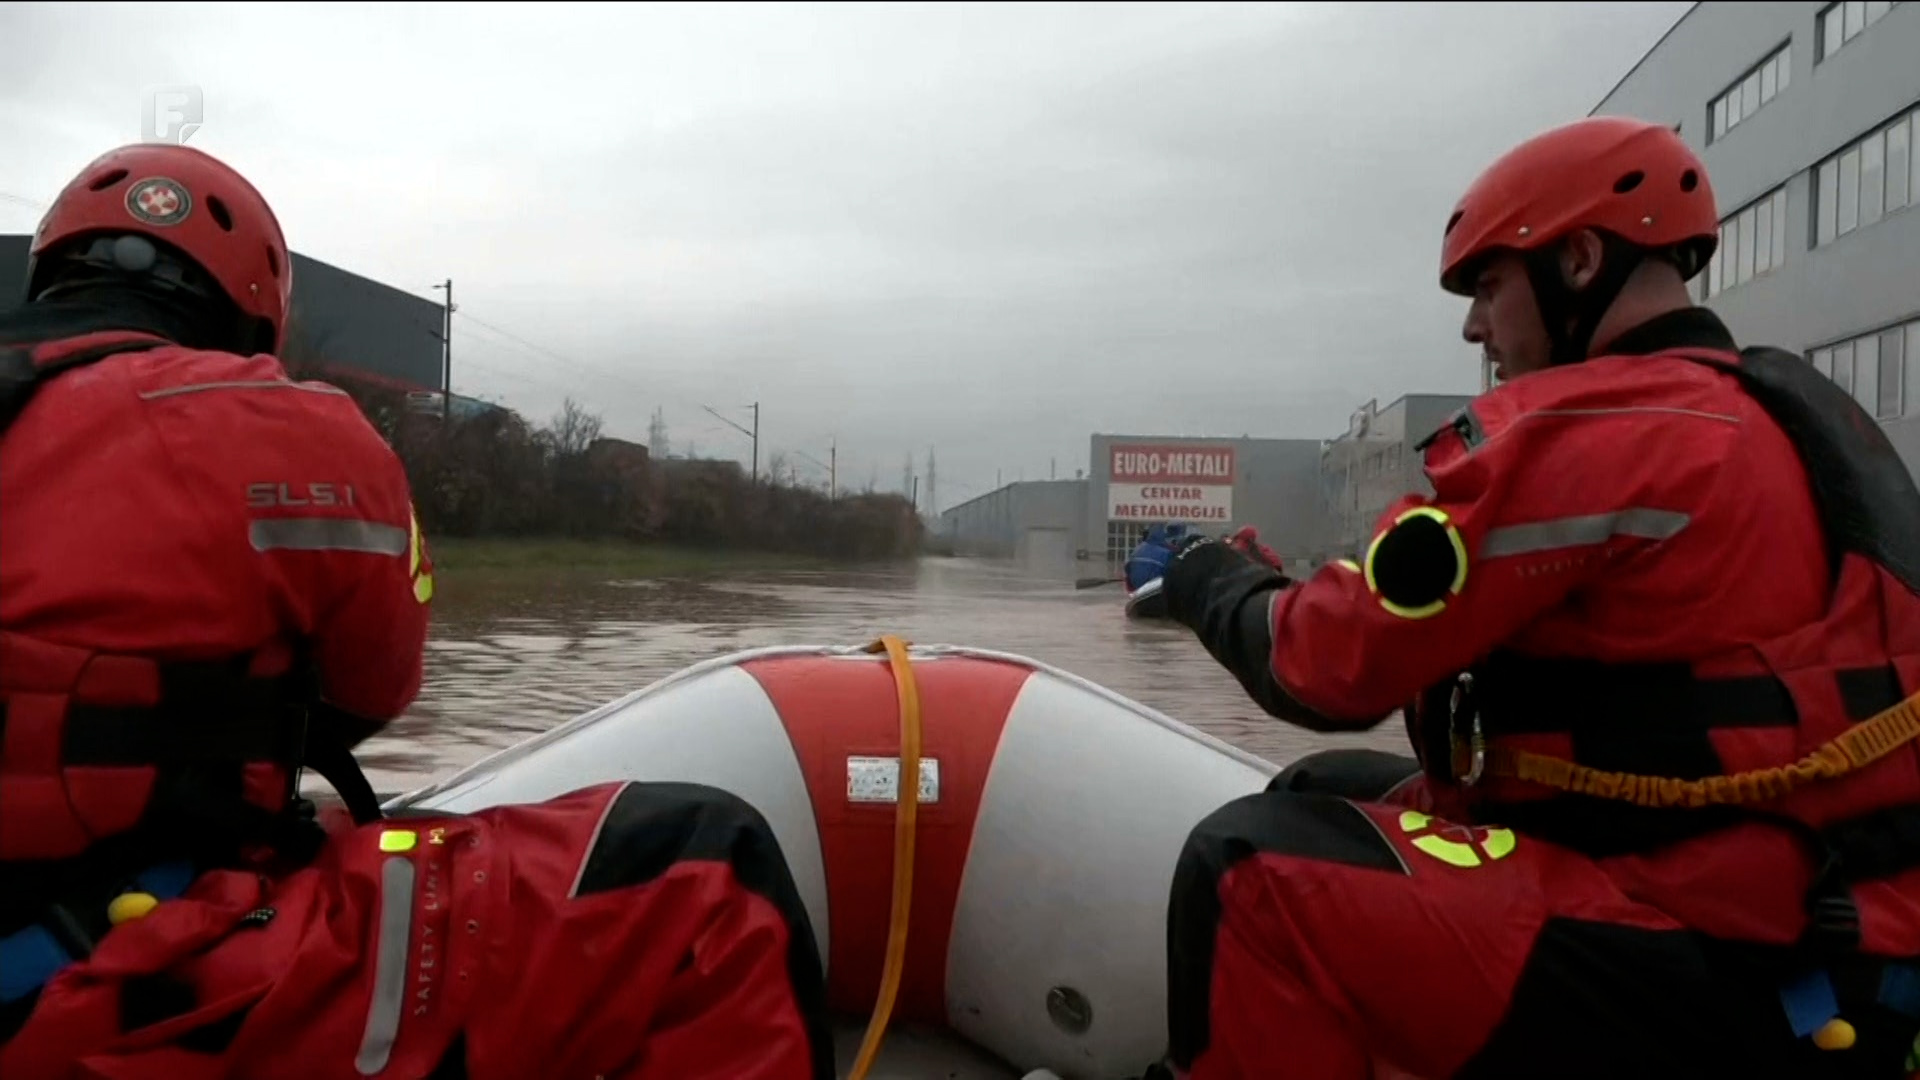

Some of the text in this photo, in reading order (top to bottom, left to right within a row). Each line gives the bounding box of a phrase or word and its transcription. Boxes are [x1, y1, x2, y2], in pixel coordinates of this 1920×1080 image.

[1113, 452, 1229, 476] EURO-METALI
[1140, 486, 1202, 499] CENTAR
[1115, 504, 1226, 518] METALURGIJE
[414, 924, 434, 1016] SAFETY
